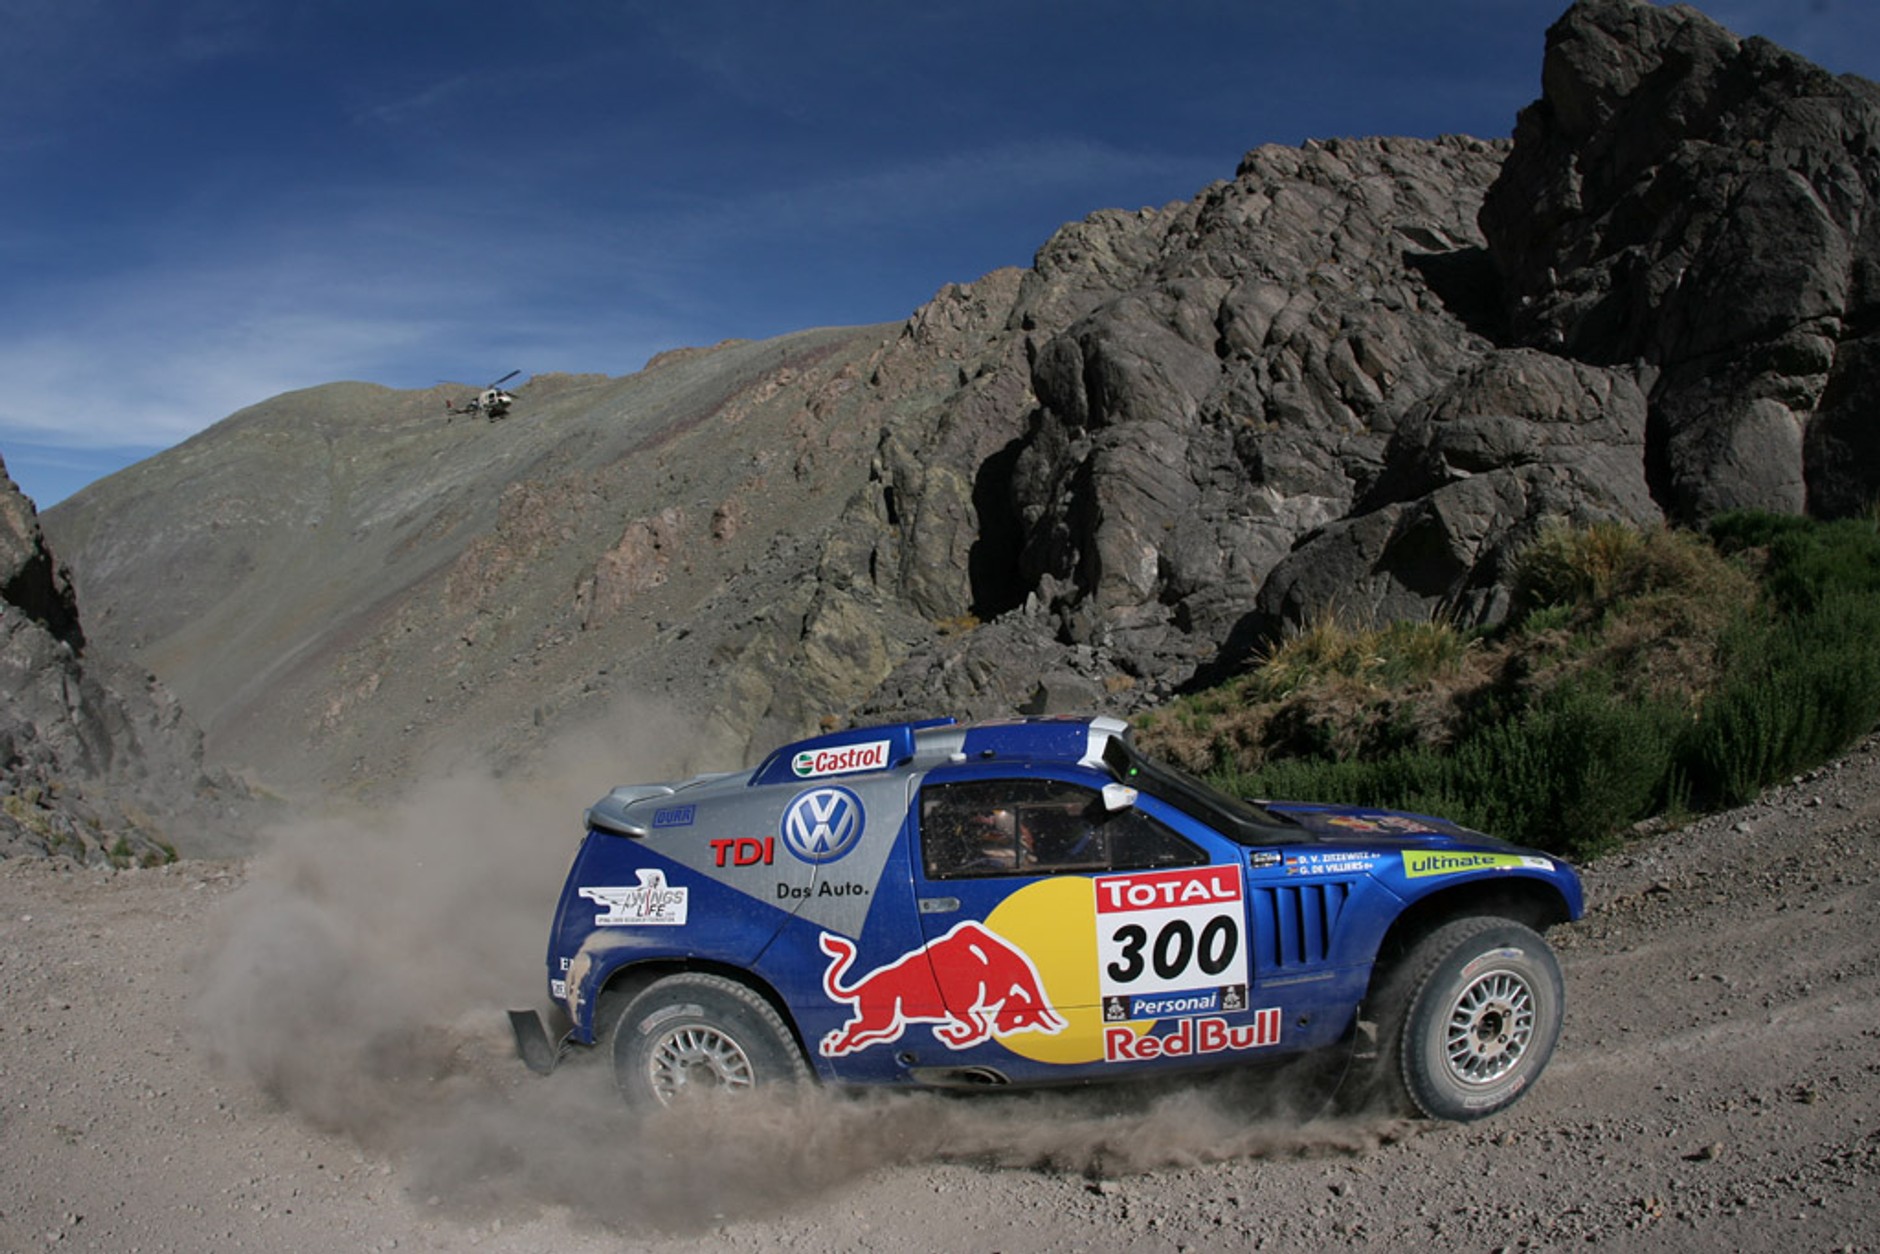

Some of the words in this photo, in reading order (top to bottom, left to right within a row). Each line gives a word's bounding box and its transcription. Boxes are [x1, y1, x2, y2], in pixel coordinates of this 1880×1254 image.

[815, 744, 882, 772] Castrol
[709, 836, 775, 867] TDI
[1411, 854, 1496, 872] ultimate
[631, 889, 684, 907] WINGS
[776, 882, 813, 900] Das
[817, 880, 870, 898] Auto.
[637, 903, 666, 917] LIFE
[1107, 914, 1239, 984] 300
[1133, 991, 1217, 1015] Personal
[1104, 1018, 1192, 1062] Red
[1197, 1007, 1281, 1054] Bull
